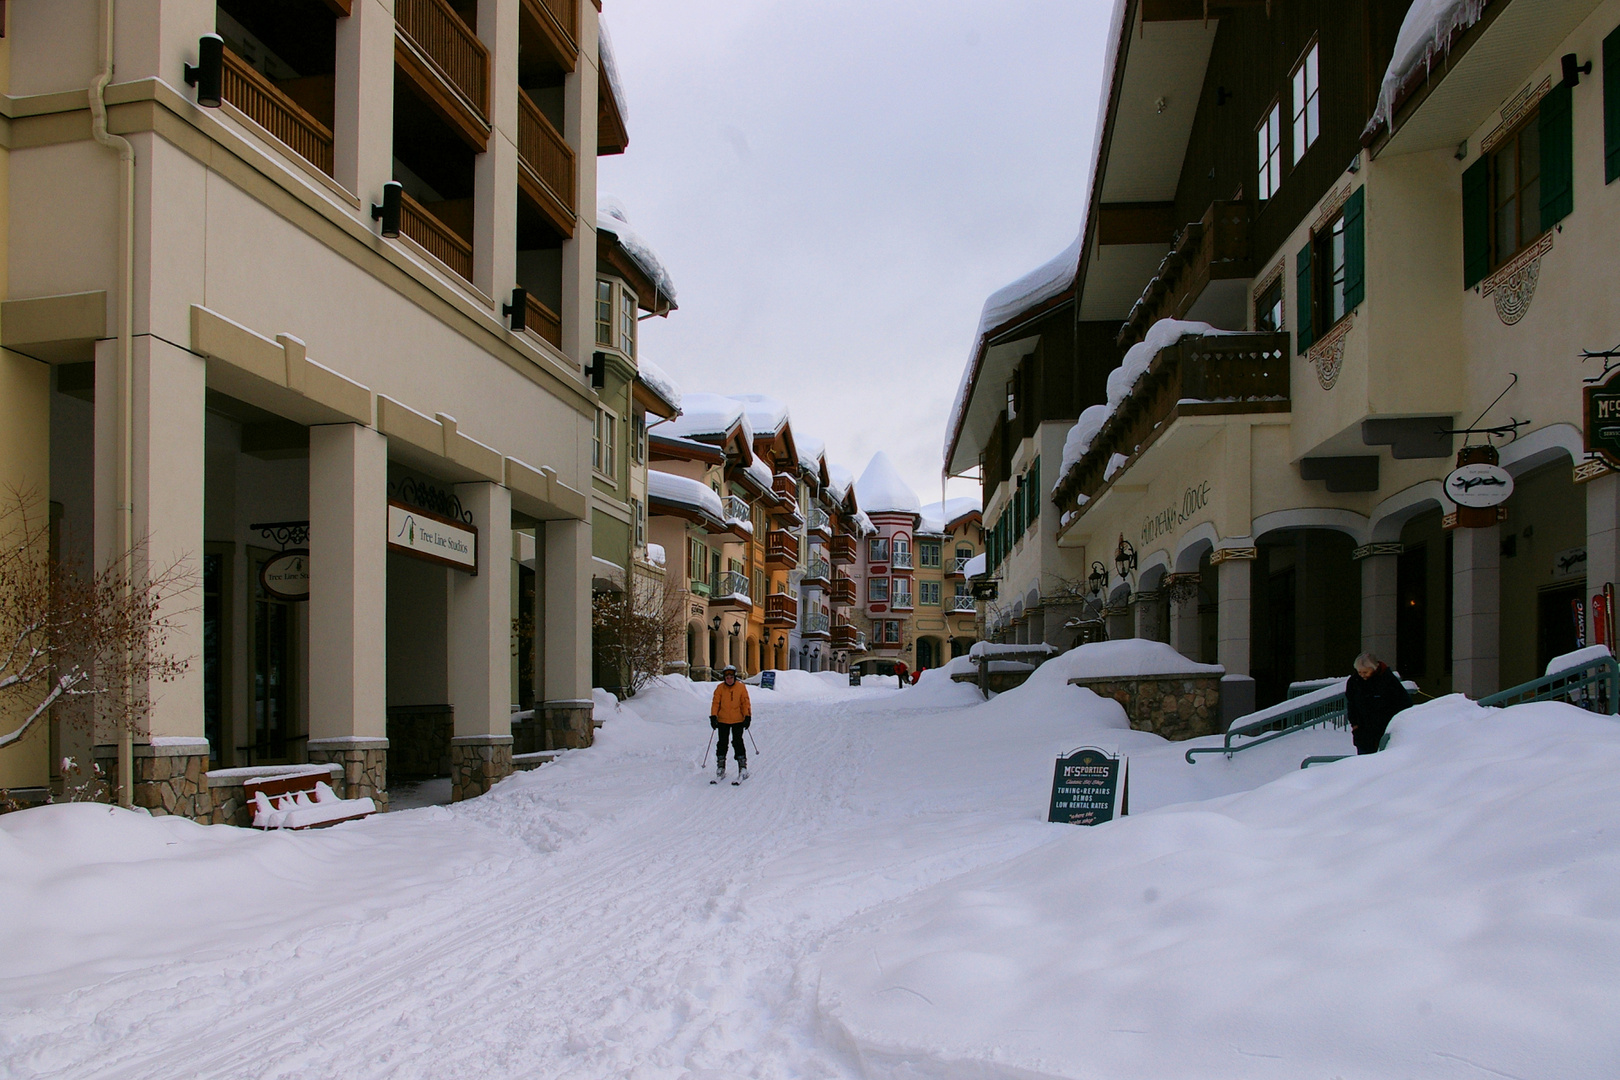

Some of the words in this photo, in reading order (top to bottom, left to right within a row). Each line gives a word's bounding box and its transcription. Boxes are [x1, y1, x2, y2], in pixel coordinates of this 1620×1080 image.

[1452, 476, 1506, 493] spa
[1178, 480, 1211, 525] LODGE
[419, 528, 433, 543] Tree
[434, 533, 447, 548] Line
[447, 537, 468, 554] Studios
[1576, 602, 1586, 646] ATOMIC
